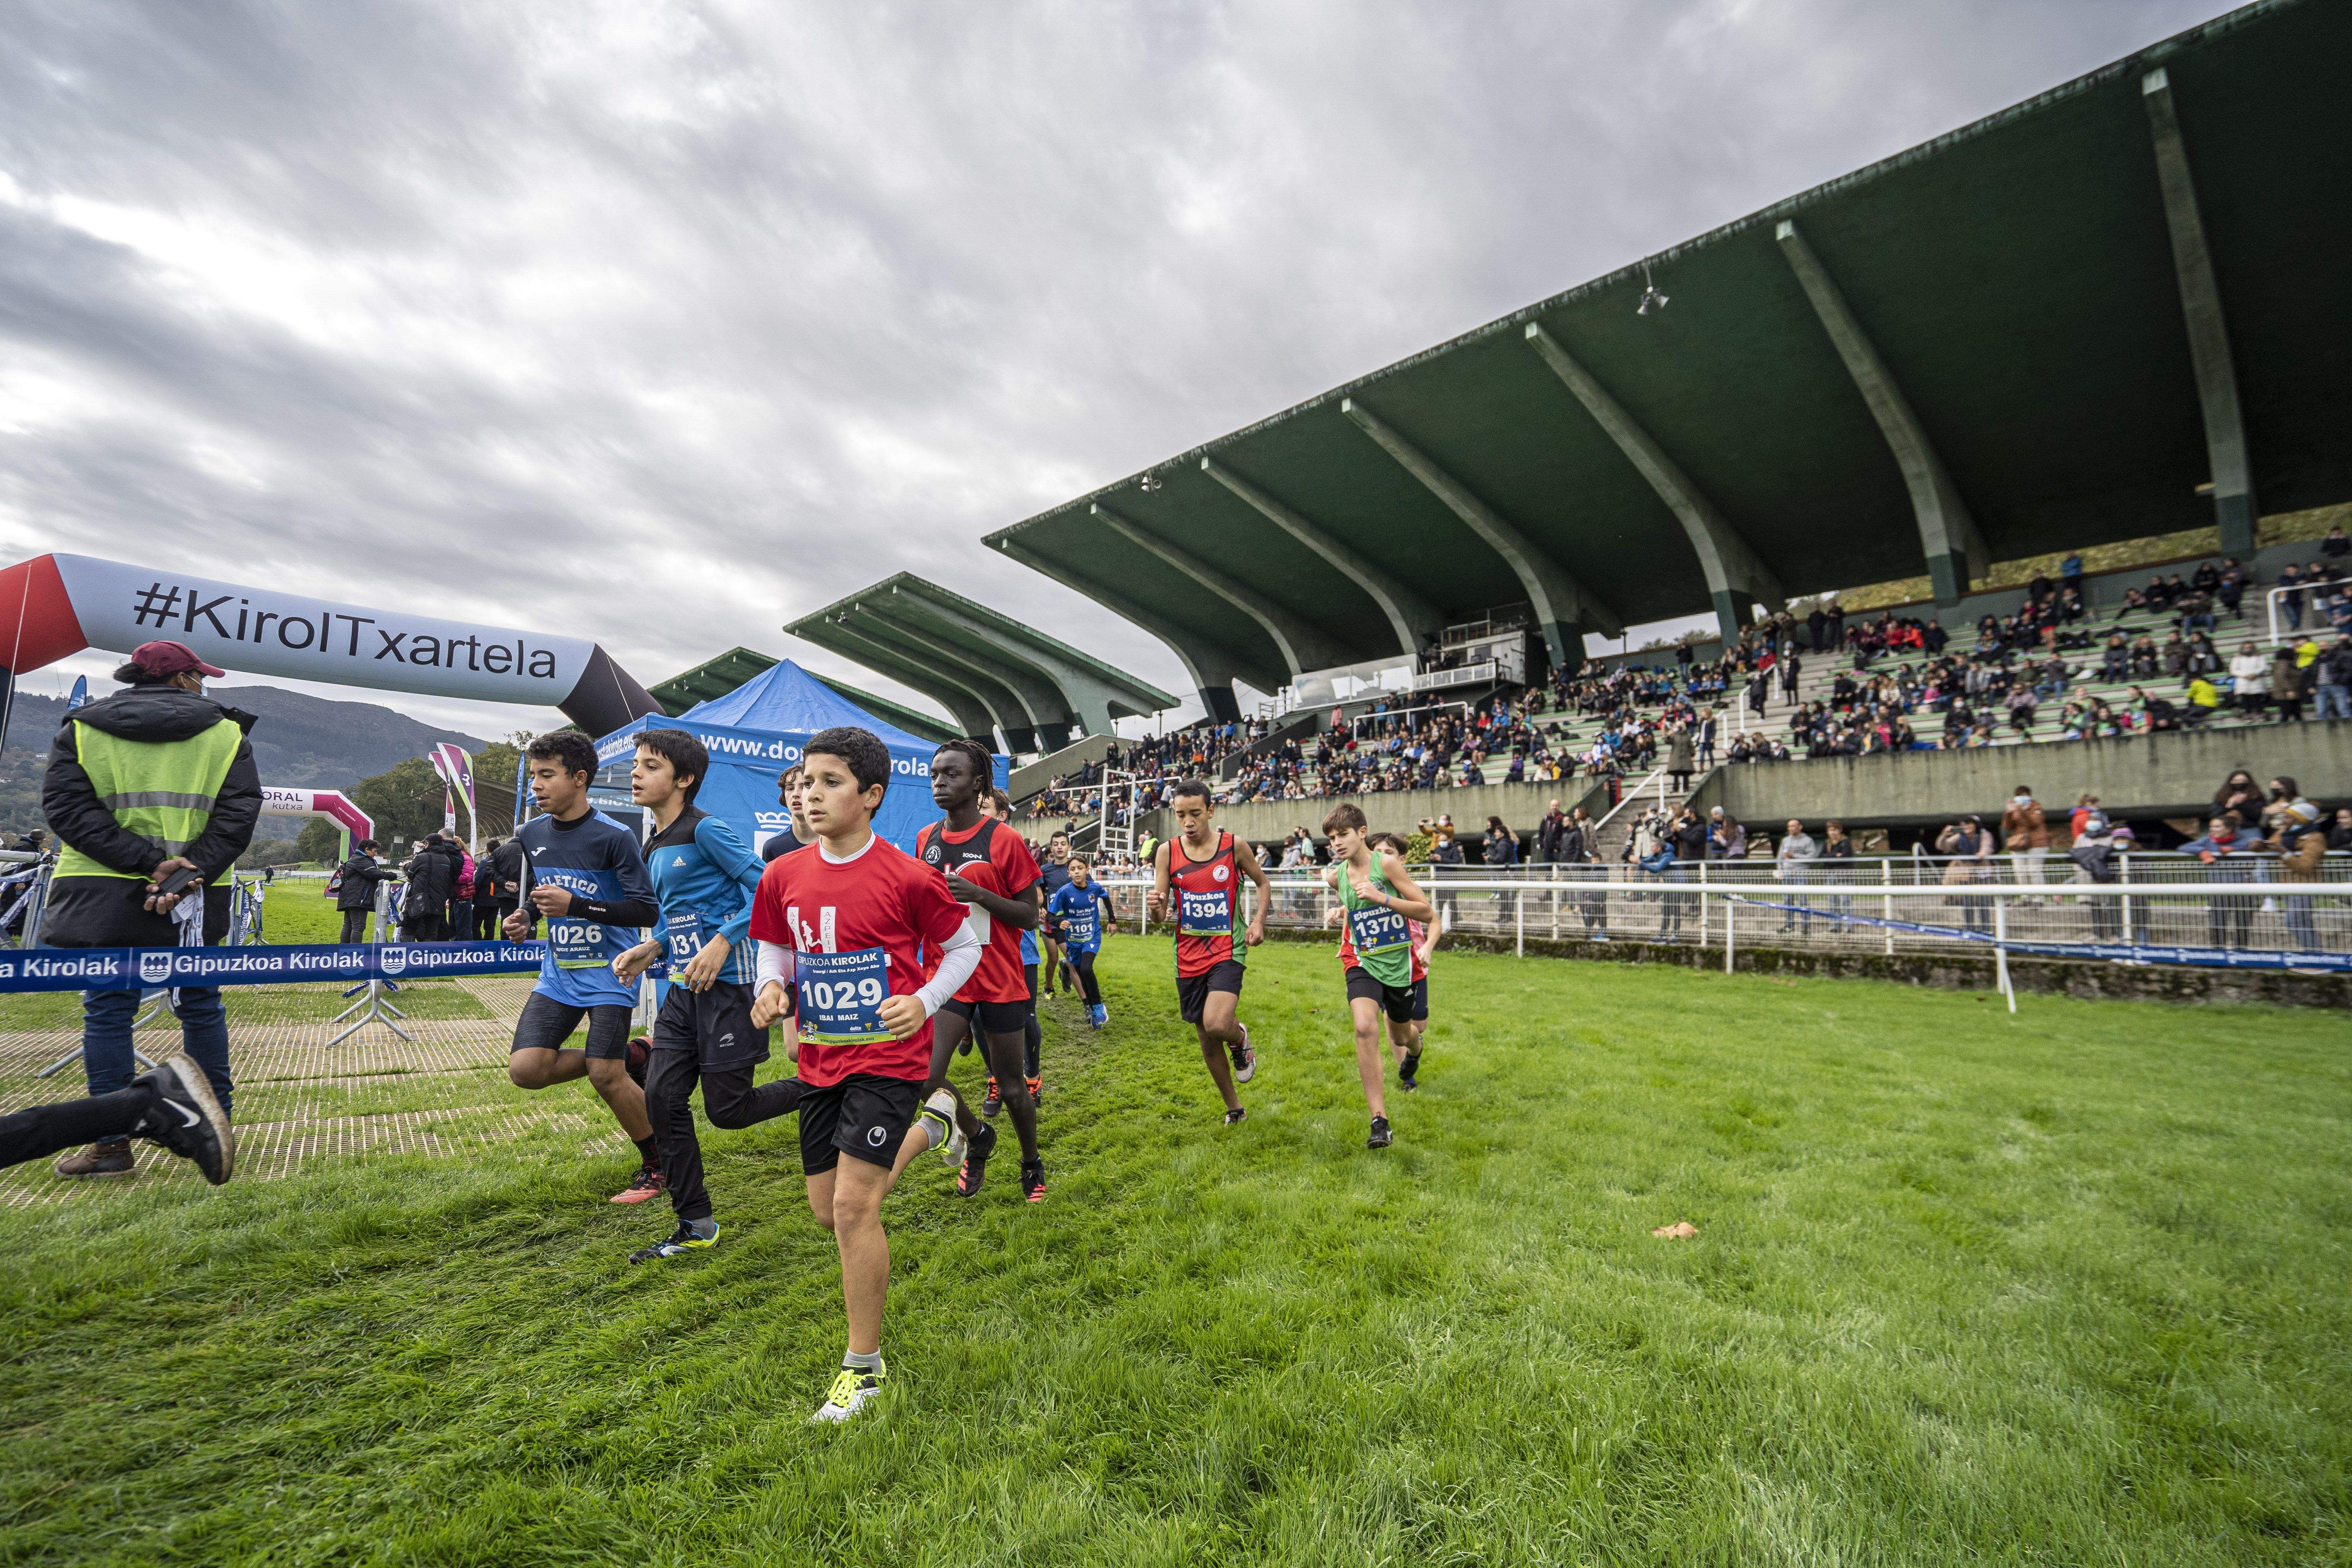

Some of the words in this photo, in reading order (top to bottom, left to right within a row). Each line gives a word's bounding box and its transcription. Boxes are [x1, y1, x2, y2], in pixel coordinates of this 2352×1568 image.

[134, 583, 556, 679] #KirolTxartela
[538, 875, 598, 895] TLETICO
[1183, 892, 1225, 901] gipuzkoa
[672, 914, 696, 924] KIROLAK
[1183, 901, 1229, 918] 1394
[550, 925, 602, 944] 1026
[1069, 923, 1093, 933] 1101
[1356, 914, 1405, 937] 1370
[23, 957, 119, 977] Kirolak
[175, 954, 282, 976] Gipuzkoa
[290, 951, 365, 969] Kirolak
[409, 949, 494, 968] Gipuzkoa
[501, 947, 546, 962] Kirola
[798, 955, 830, 966] GIPUZKOA
[831, 952, 878, 965] KIROLAK
[801, 978, 882, 1009] 1029
